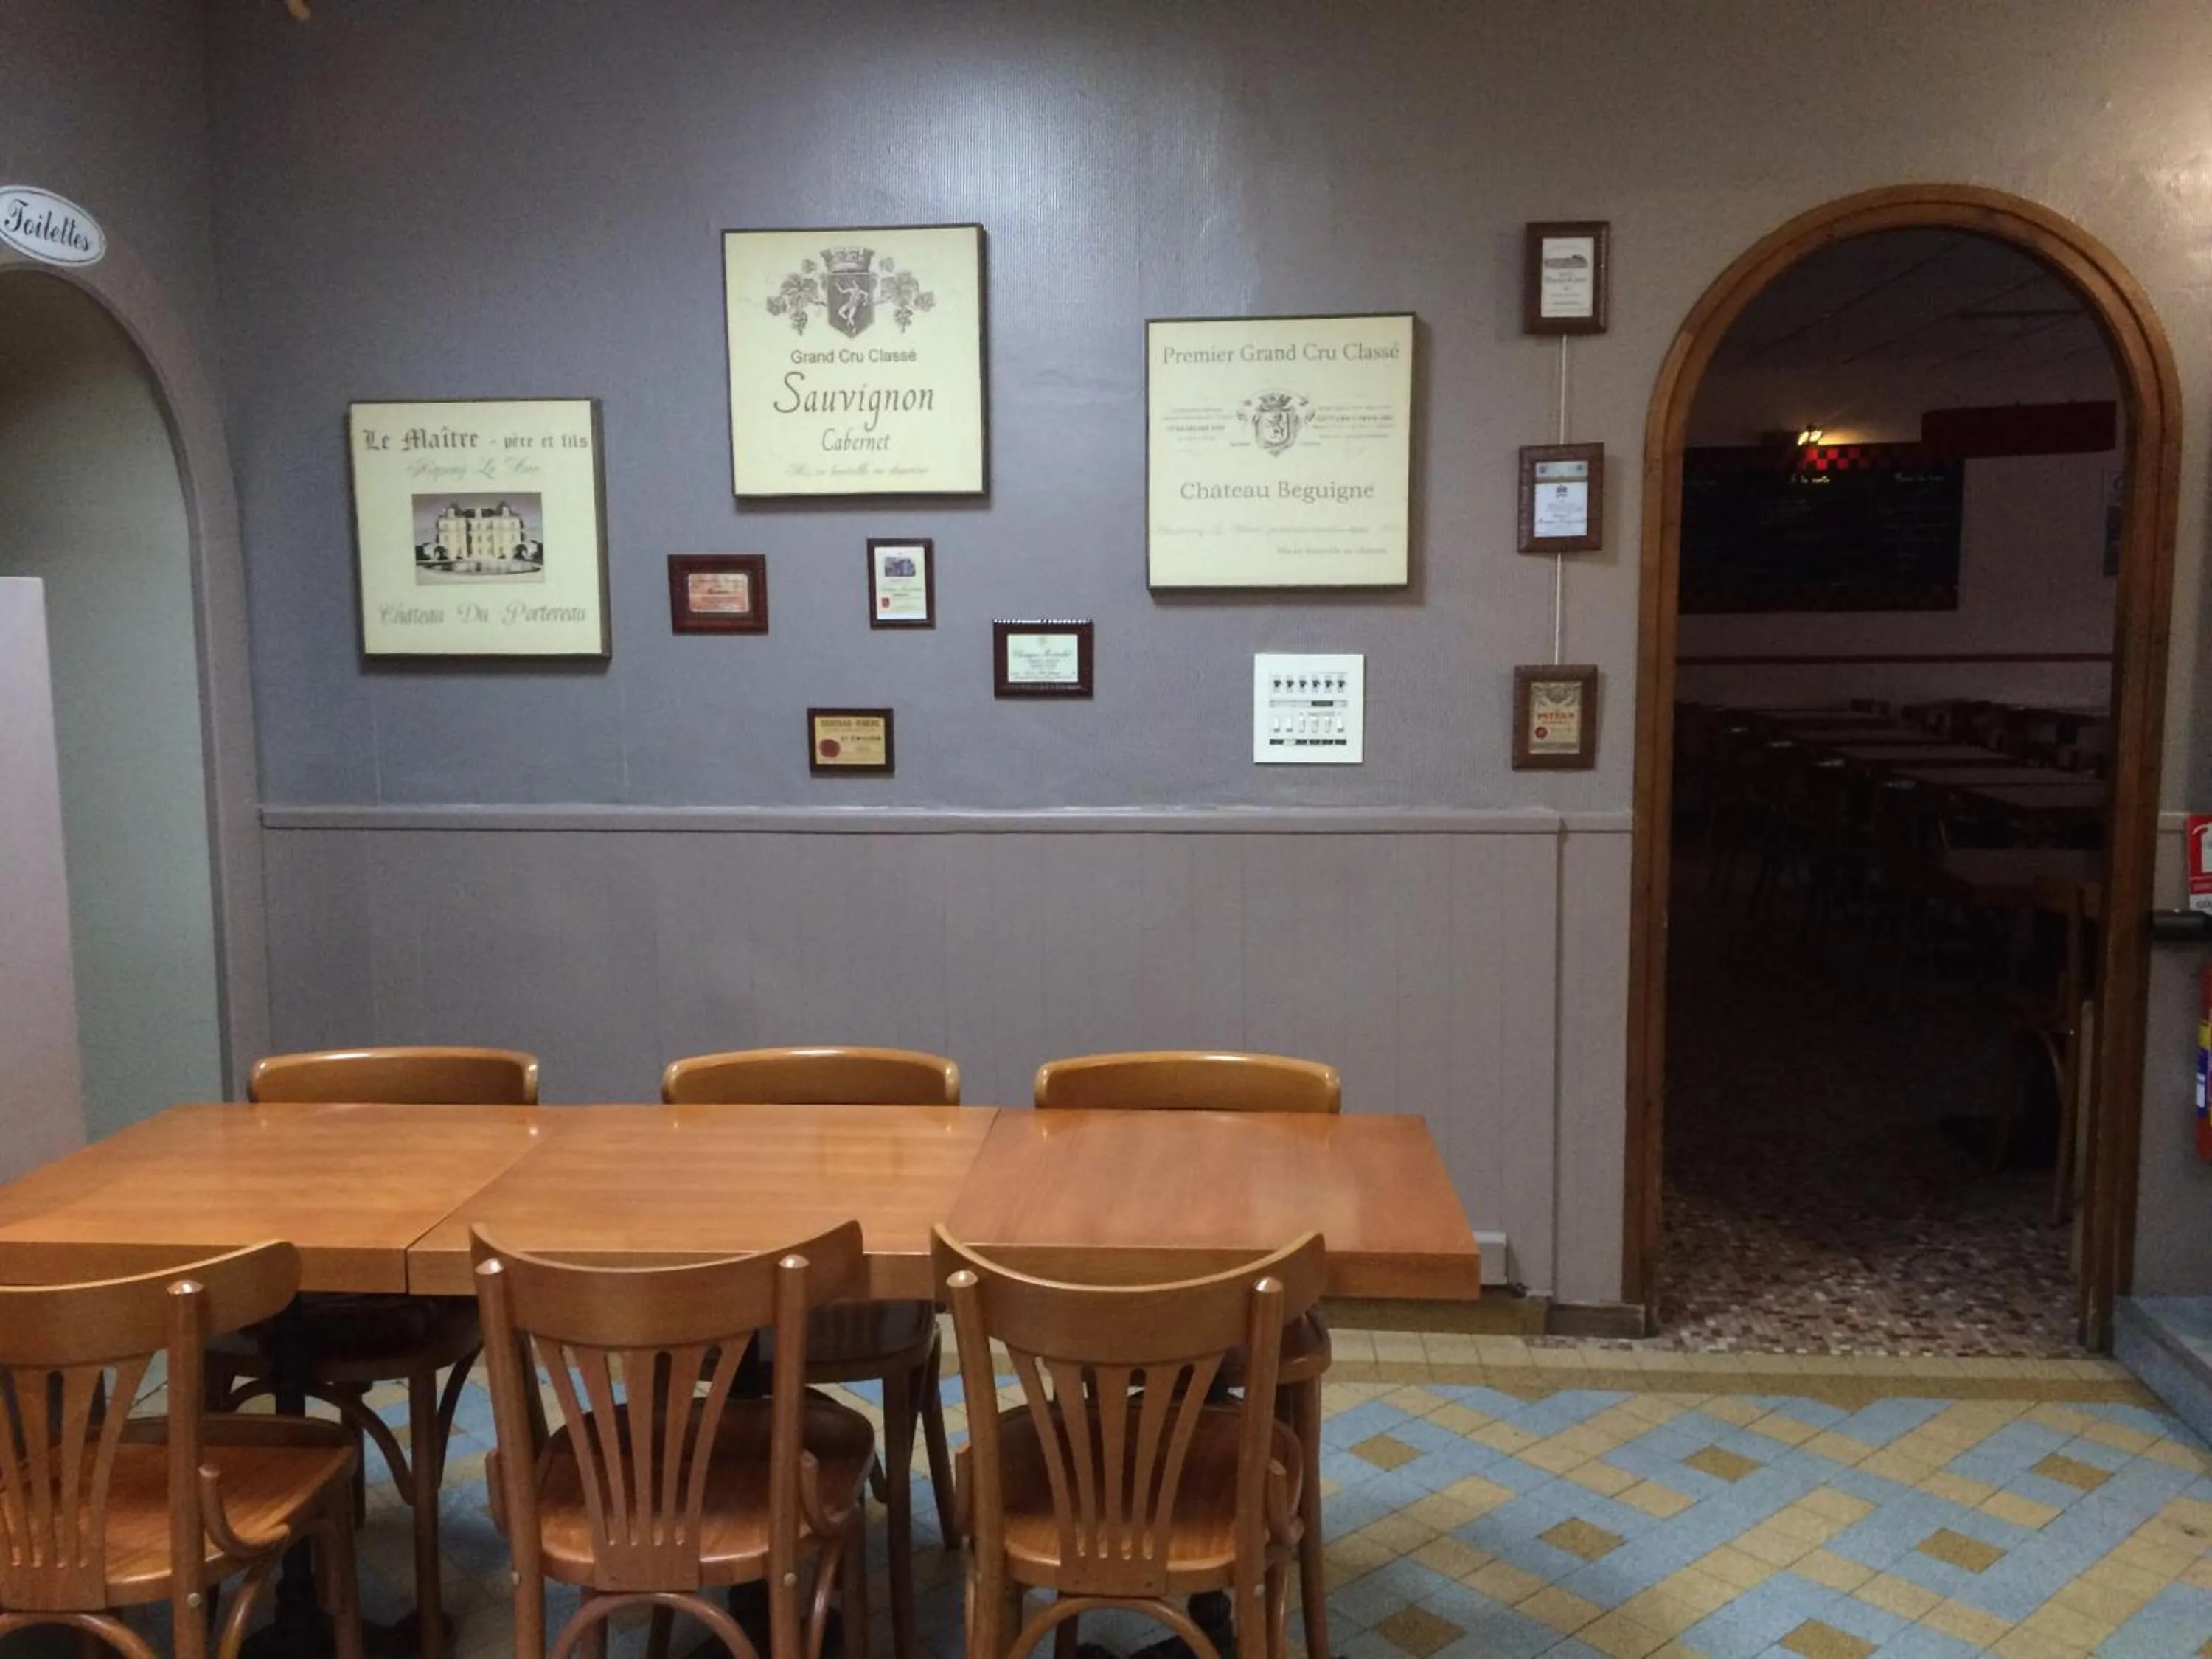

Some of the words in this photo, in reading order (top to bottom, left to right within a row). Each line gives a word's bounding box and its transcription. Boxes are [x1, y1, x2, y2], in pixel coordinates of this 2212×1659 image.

[4, 199, 90, 251] Toilettes
[790, 349, 835, 364] Grand
[839, 349, 863, 363] Cru
[869, 347, 917, 362] Classé
[1164, 346, 1234, 364] Premier
[1240, 343, 1296, 361] Grand
[1303, 343, 1336, 361] Cru
[1343, 341, 1400, 361] Classé
[773, 371, 933, 432] Sauvignon
[361, 429, 390, 451] Le
[401, 425, 479, 451] Maître
[541, 436, 554, 448] et
[561, 434, 588, 448] fils
[821, 428, 889, 451] Cabernet
